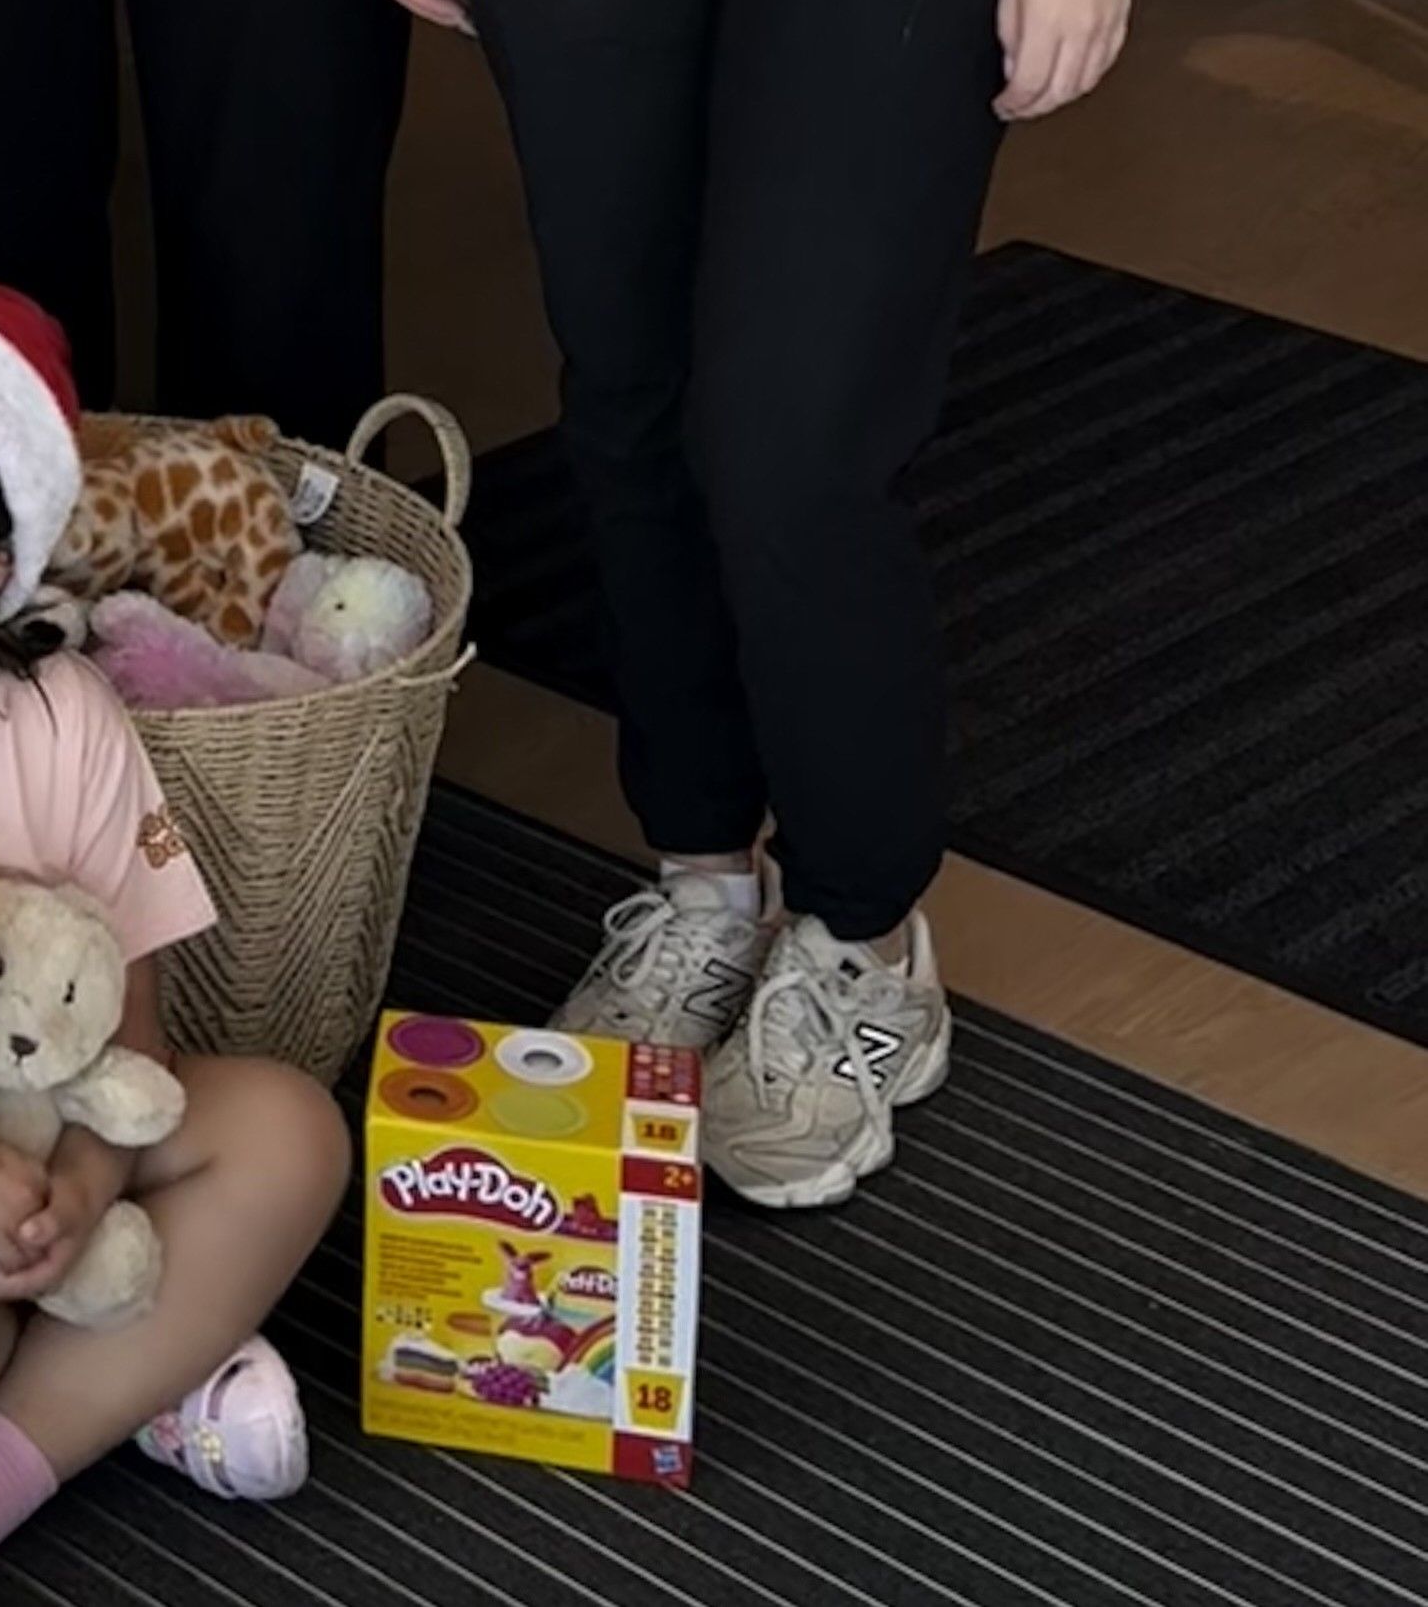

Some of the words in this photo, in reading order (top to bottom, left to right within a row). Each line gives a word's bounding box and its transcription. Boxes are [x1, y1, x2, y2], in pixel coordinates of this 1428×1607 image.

[642, 1122, 678, 1141] 18
[663, 1164, 693, 1190] 2+
[382, 1160, 554, 1224] Play-Doh
[636, 1383, 674, 1414] 18
